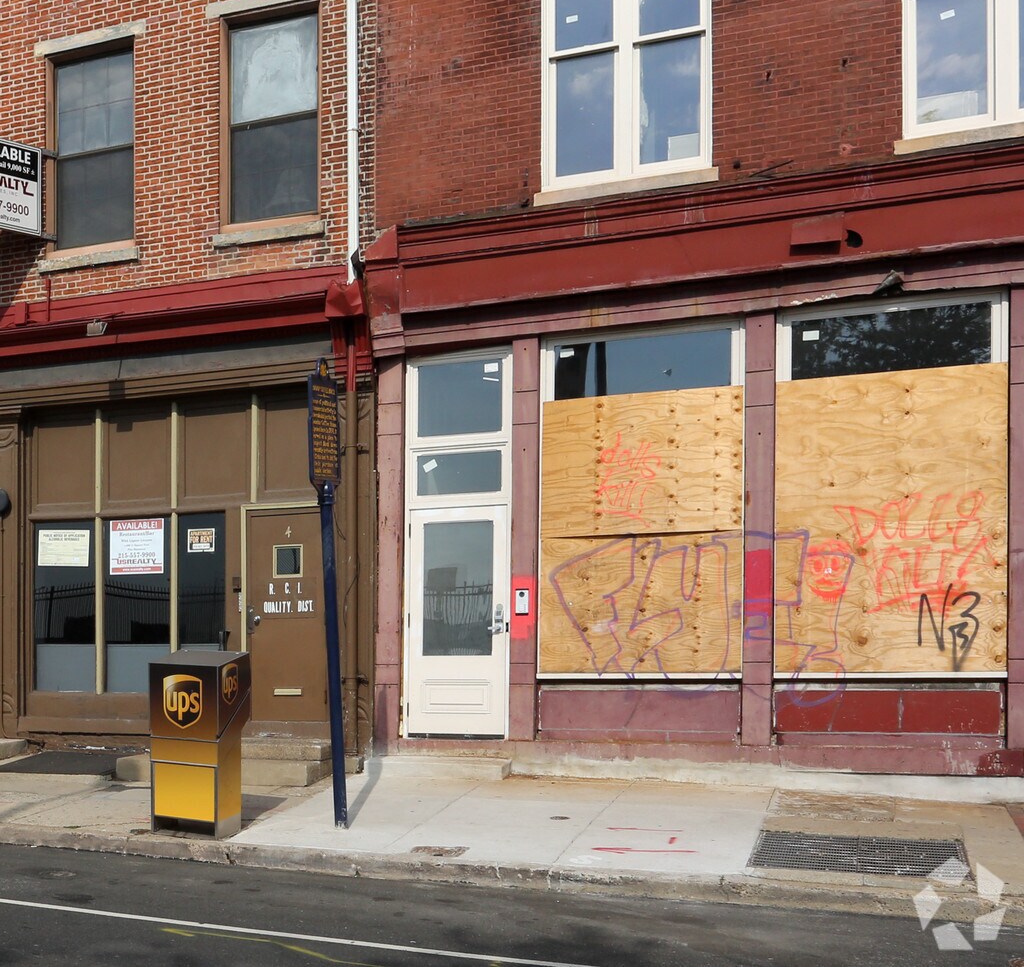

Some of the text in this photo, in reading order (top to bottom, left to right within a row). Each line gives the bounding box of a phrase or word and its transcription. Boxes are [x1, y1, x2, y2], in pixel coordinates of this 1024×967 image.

[116, 521, 158, 530] AVAILABLE!
[284, 525, 292, 538] 4
[200, 535, 213, 543] RENT
